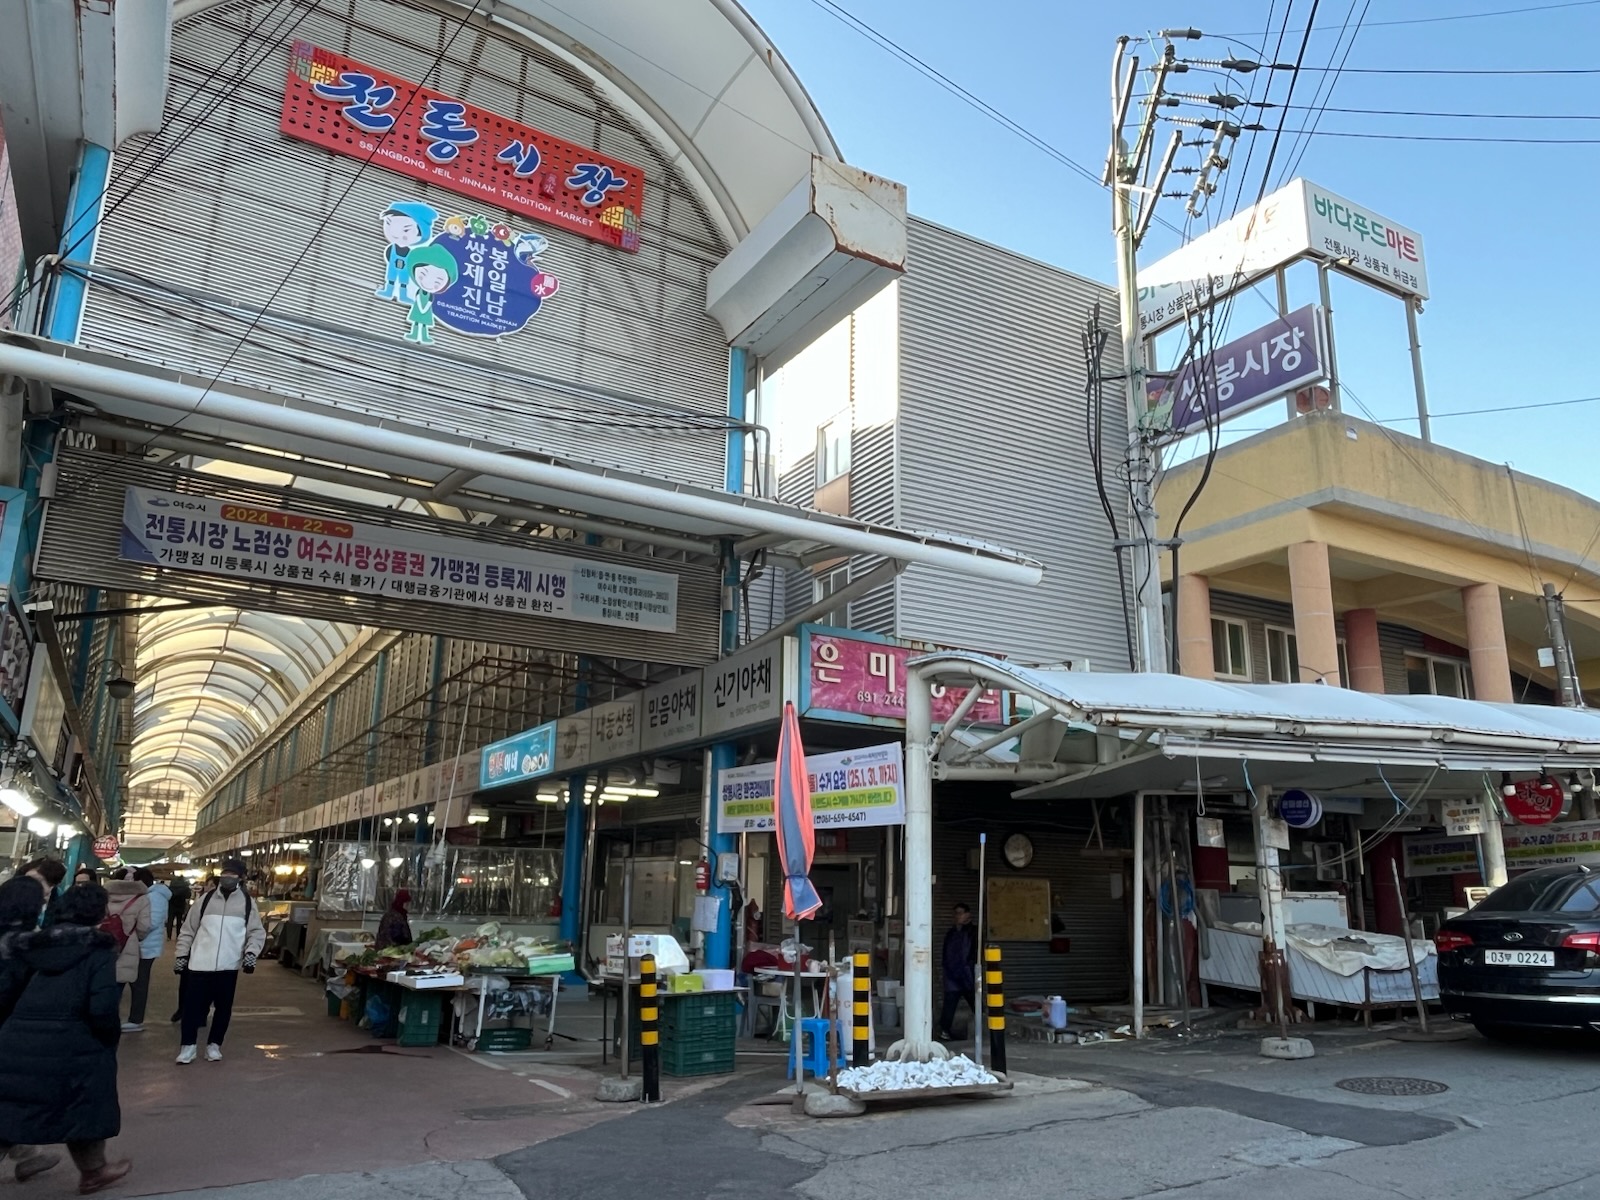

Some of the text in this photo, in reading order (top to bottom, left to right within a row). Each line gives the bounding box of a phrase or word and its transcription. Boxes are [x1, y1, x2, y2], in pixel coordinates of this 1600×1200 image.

[313, 72, 628, 208] 전통시장
[458, 175, 496, 194] JINNAM
[500, 189, 552, 213] TRADITION
[555, 208, 595, 227] MARKET
[1313, 193, 1419, 262] 바다푸드마트
[462, 262, 507, 294] 제일
[465, 240, 509, 271] 쌍봉
[1324, 236, 1418, 289] 전통시장 상품권 취급점
[461, 286, 507, 317] 진남
[1139, 306, 1164, 330] 통시장
[1179, 326, 1305, 413] 쌍봉시장
[172, 500, 207, 513] 여수시
[145, 513, 566, 599] 전통시장 노점상 여수사랑상품권 가맹점 등록제 시행
[159, 547, 204, 566] 가맹점
[210, 554, 267, 575] 미등록시
[273, 562, 314, 581] 상품권
[318, 568, 345, 586] 수취
[349, 572, 376, 590] 불가
[391, 579, 489, 605] 대행금융기관에서
[493, 594, 528, 610] 상품권
[531, 598, 554, 613] 환전
[648, 684, 697, 729] 믿음야채
[713, 657, 772, 709] 신기야채
[857, 690, 877, 703] 691
[1517, 952, 1548, 965] 0224
